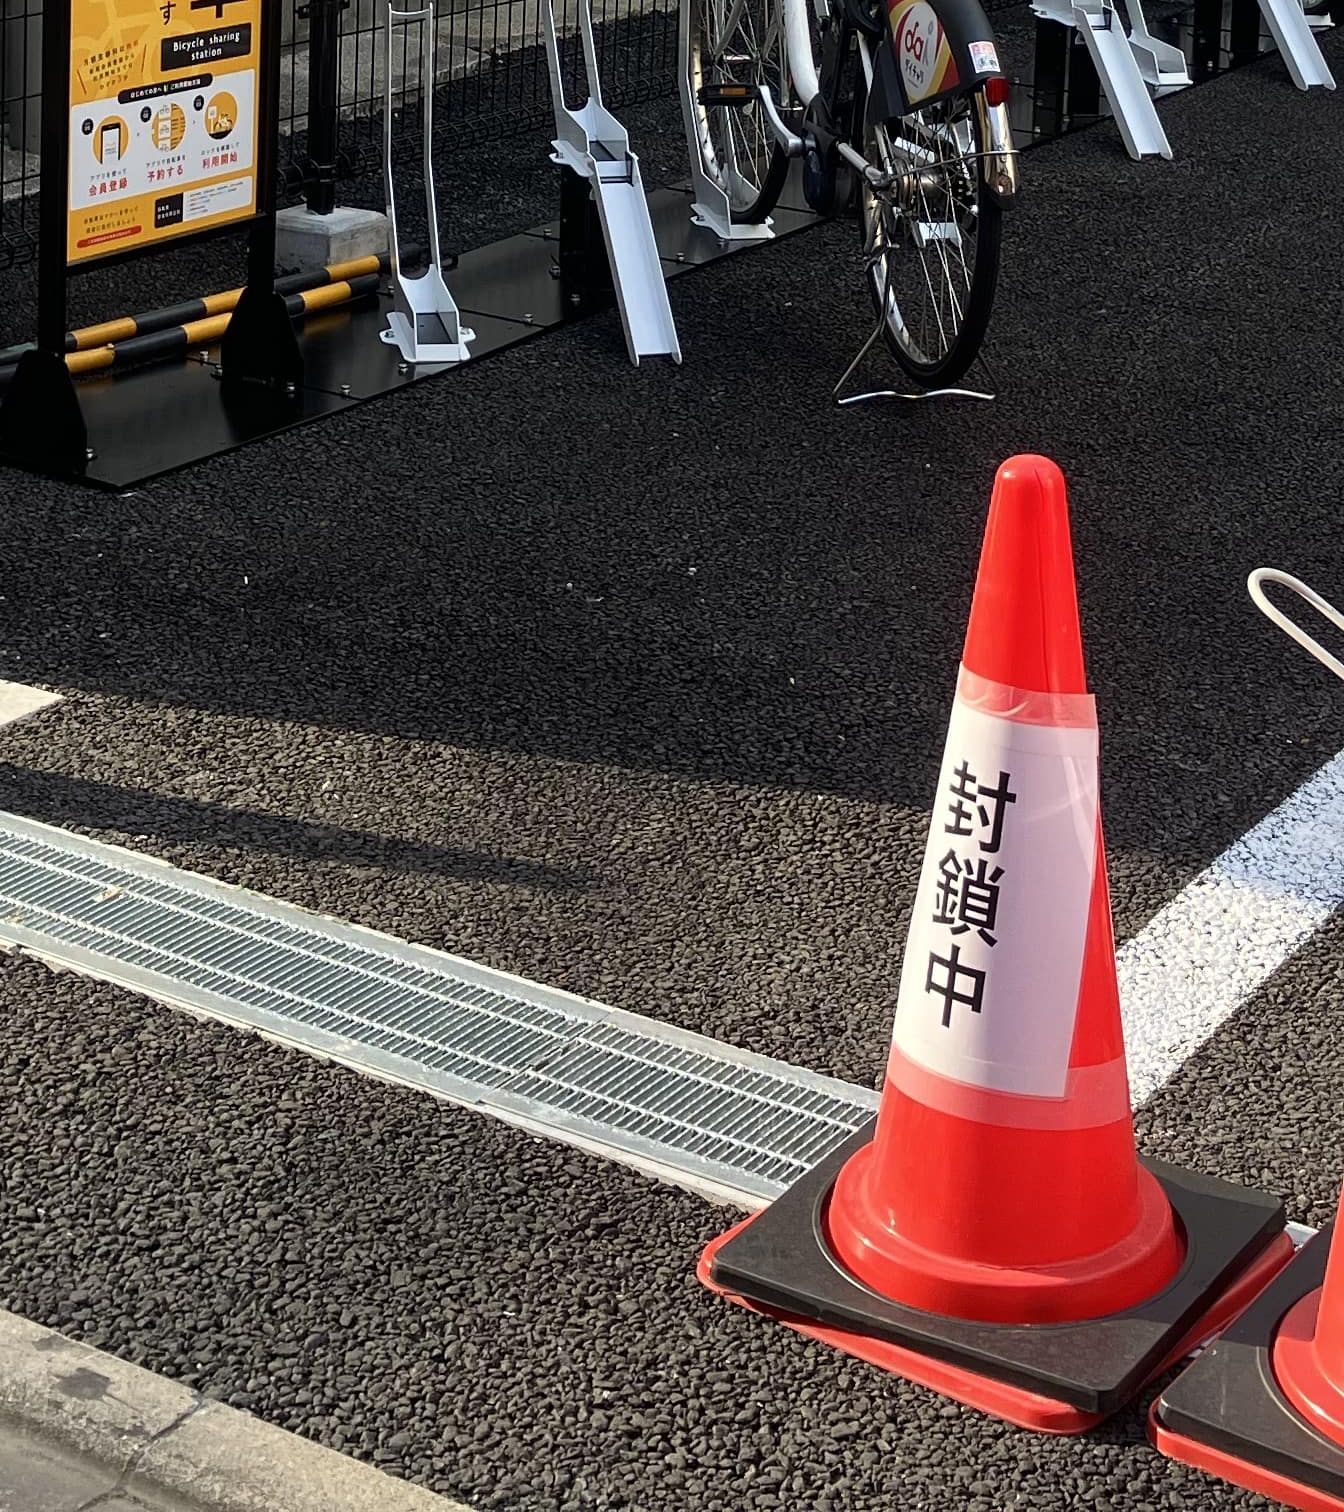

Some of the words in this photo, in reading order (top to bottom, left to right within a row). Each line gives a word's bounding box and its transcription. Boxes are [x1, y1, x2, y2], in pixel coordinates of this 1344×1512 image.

[173, 36, 205, 52] Bicycle
[209, 31, 240, 45] sharing
[191, 46, 222, 61] station
[202, 151, 239, 169] 利用開始
[146, 163, 184, 183] 予約する
[88, 177, 128, 197] 会員登録
[924, 760, 1017, 1028] 封鎖中
